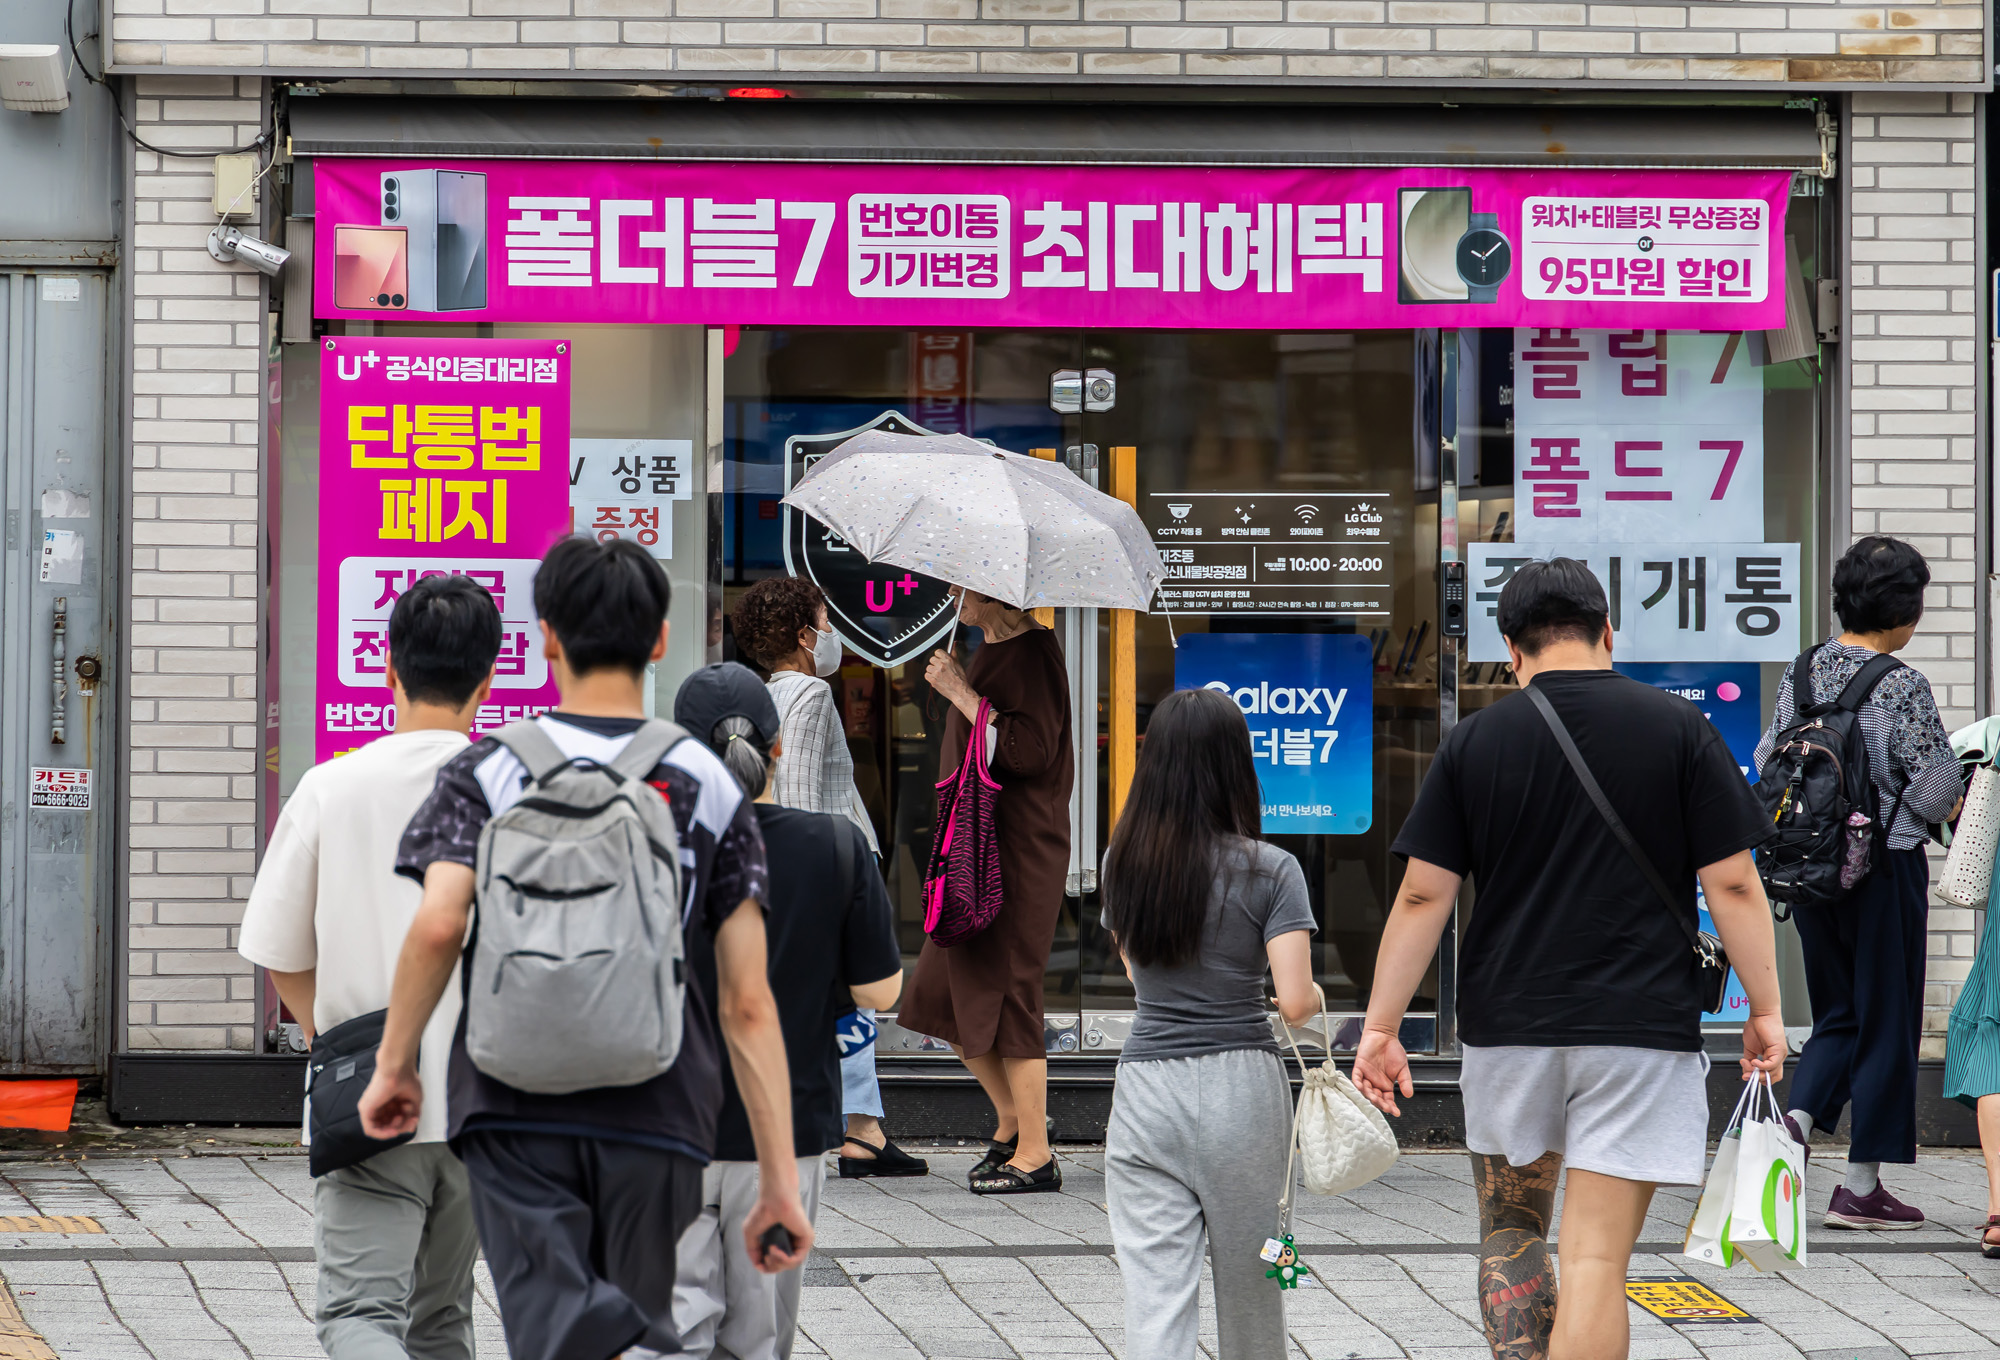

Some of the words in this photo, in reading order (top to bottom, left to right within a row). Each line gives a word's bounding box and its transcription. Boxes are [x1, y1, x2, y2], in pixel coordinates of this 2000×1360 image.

[859, 203, 999, 238] 번호이동
[1531, 204, 1662, 230] 워치+태블릿
[1667, 204, 1761, 231] 무상증정
[505, 196, 836, 288] 폴더블7
[1021, 201, 1384, 293] 최대혜택
[1638, 238, 1652, 249] or
[859, 252, 999, 288] 기기변경
[1539, 257, 1665, 297] 95만원
[1677, 257, 1752, 297] 할인
[337, 350, 381, 381] U+
[386, 356, 558, 384] 공식인증대리점
[347, 404, 541, 471] 단통법
[611, 455, 681, 494] 상품
[1521, 438, 1673, 518] 폴드
[1699, 440, 1744, 501] 7
[378, 478, 508, 544] 폐지
[592, 506, 660, 546] 증정
[1345, 514, 1359, 523] LG
[1360, 513, 1383, 523] Club
[1157, 528, 1179, 536] CCTV
[1288, 557, 1330, 572] 10:00
[1339, 557, 1383, 572] 20:00
[865, 574, 919, 613] U+
[1196, 590, 1210, 598] CCTV
[35, 771, 76, 783] 카드
